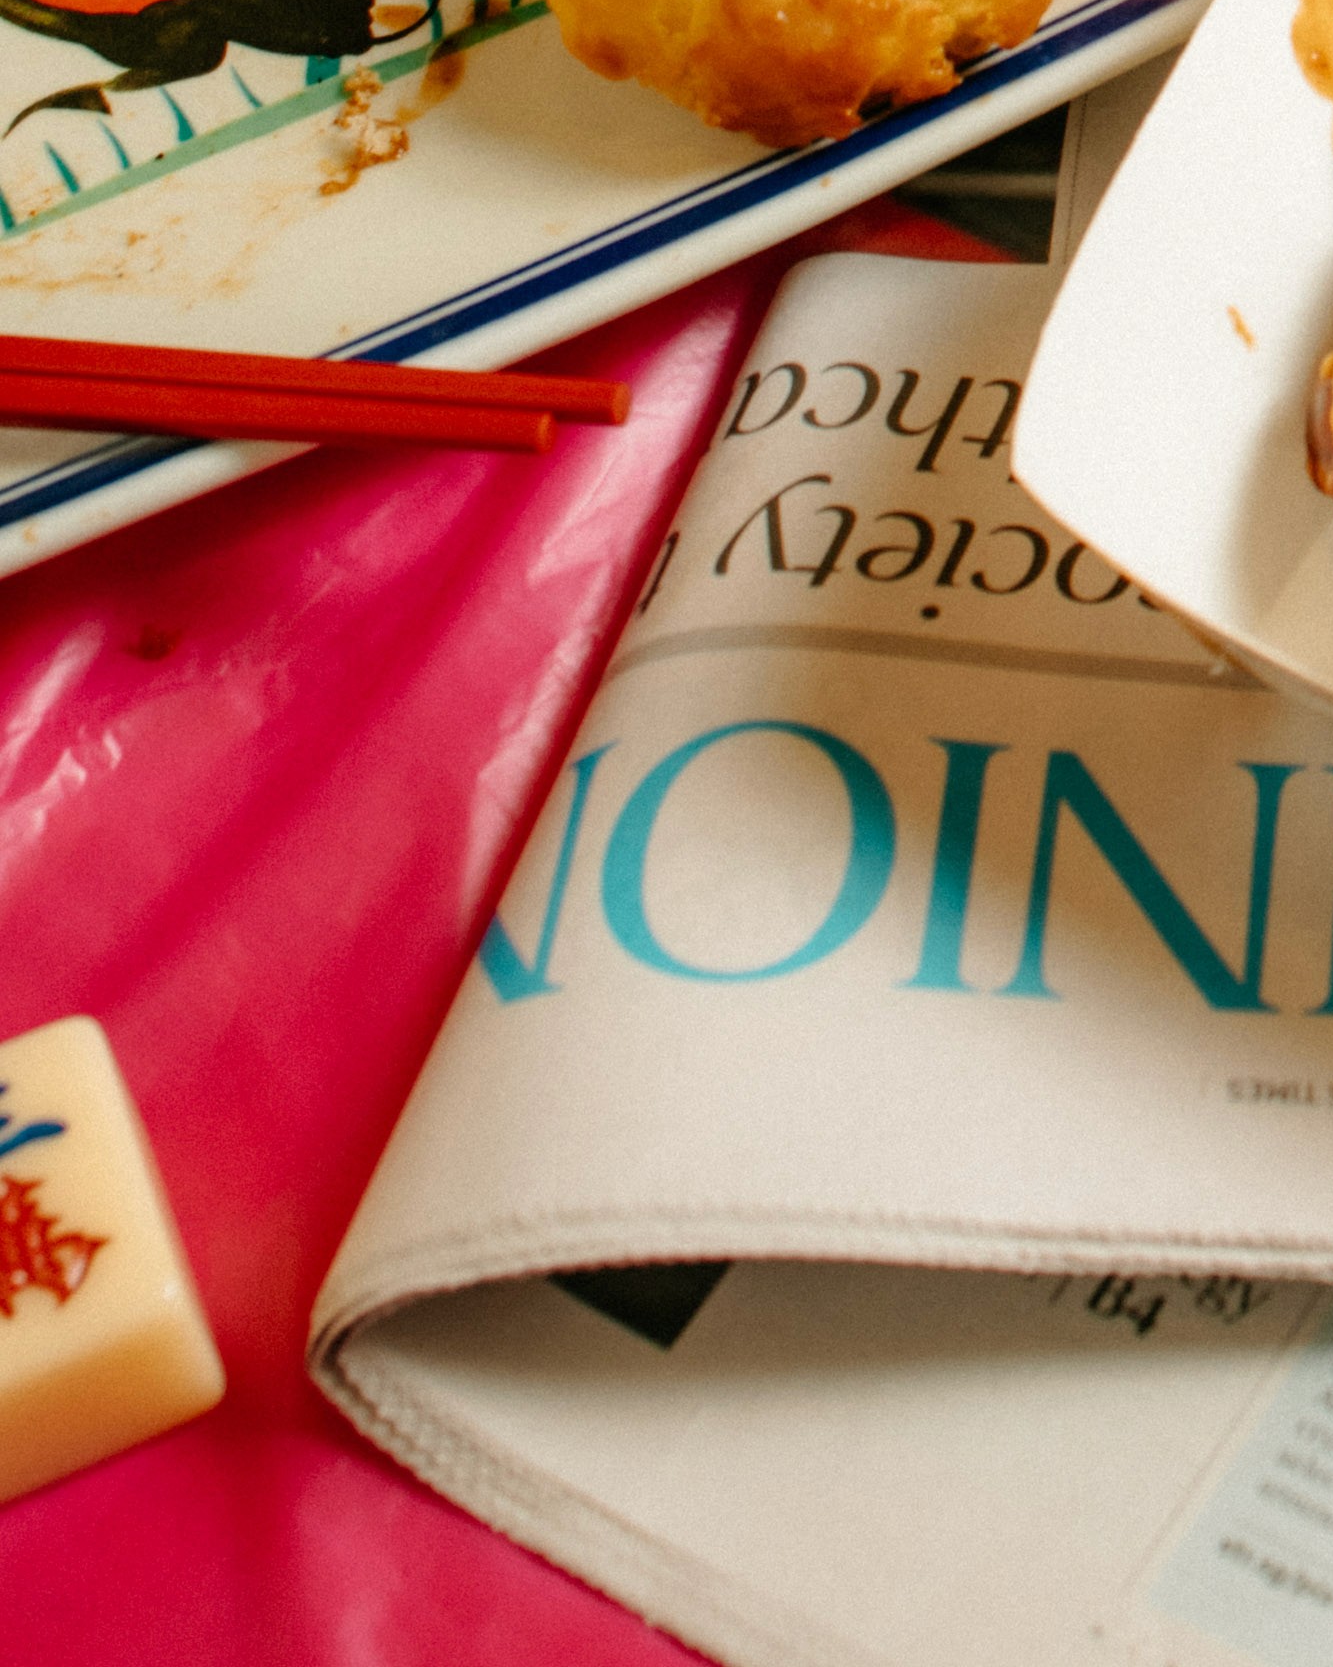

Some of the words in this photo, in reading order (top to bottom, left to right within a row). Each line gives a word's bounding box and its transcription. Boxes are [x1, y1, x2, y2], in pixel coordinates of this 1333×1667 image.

[724, 361, 1023, 473] thca
[714, 473, 1164, 621] ociety
[1226, 1078, 1317, 1104] TIMES
